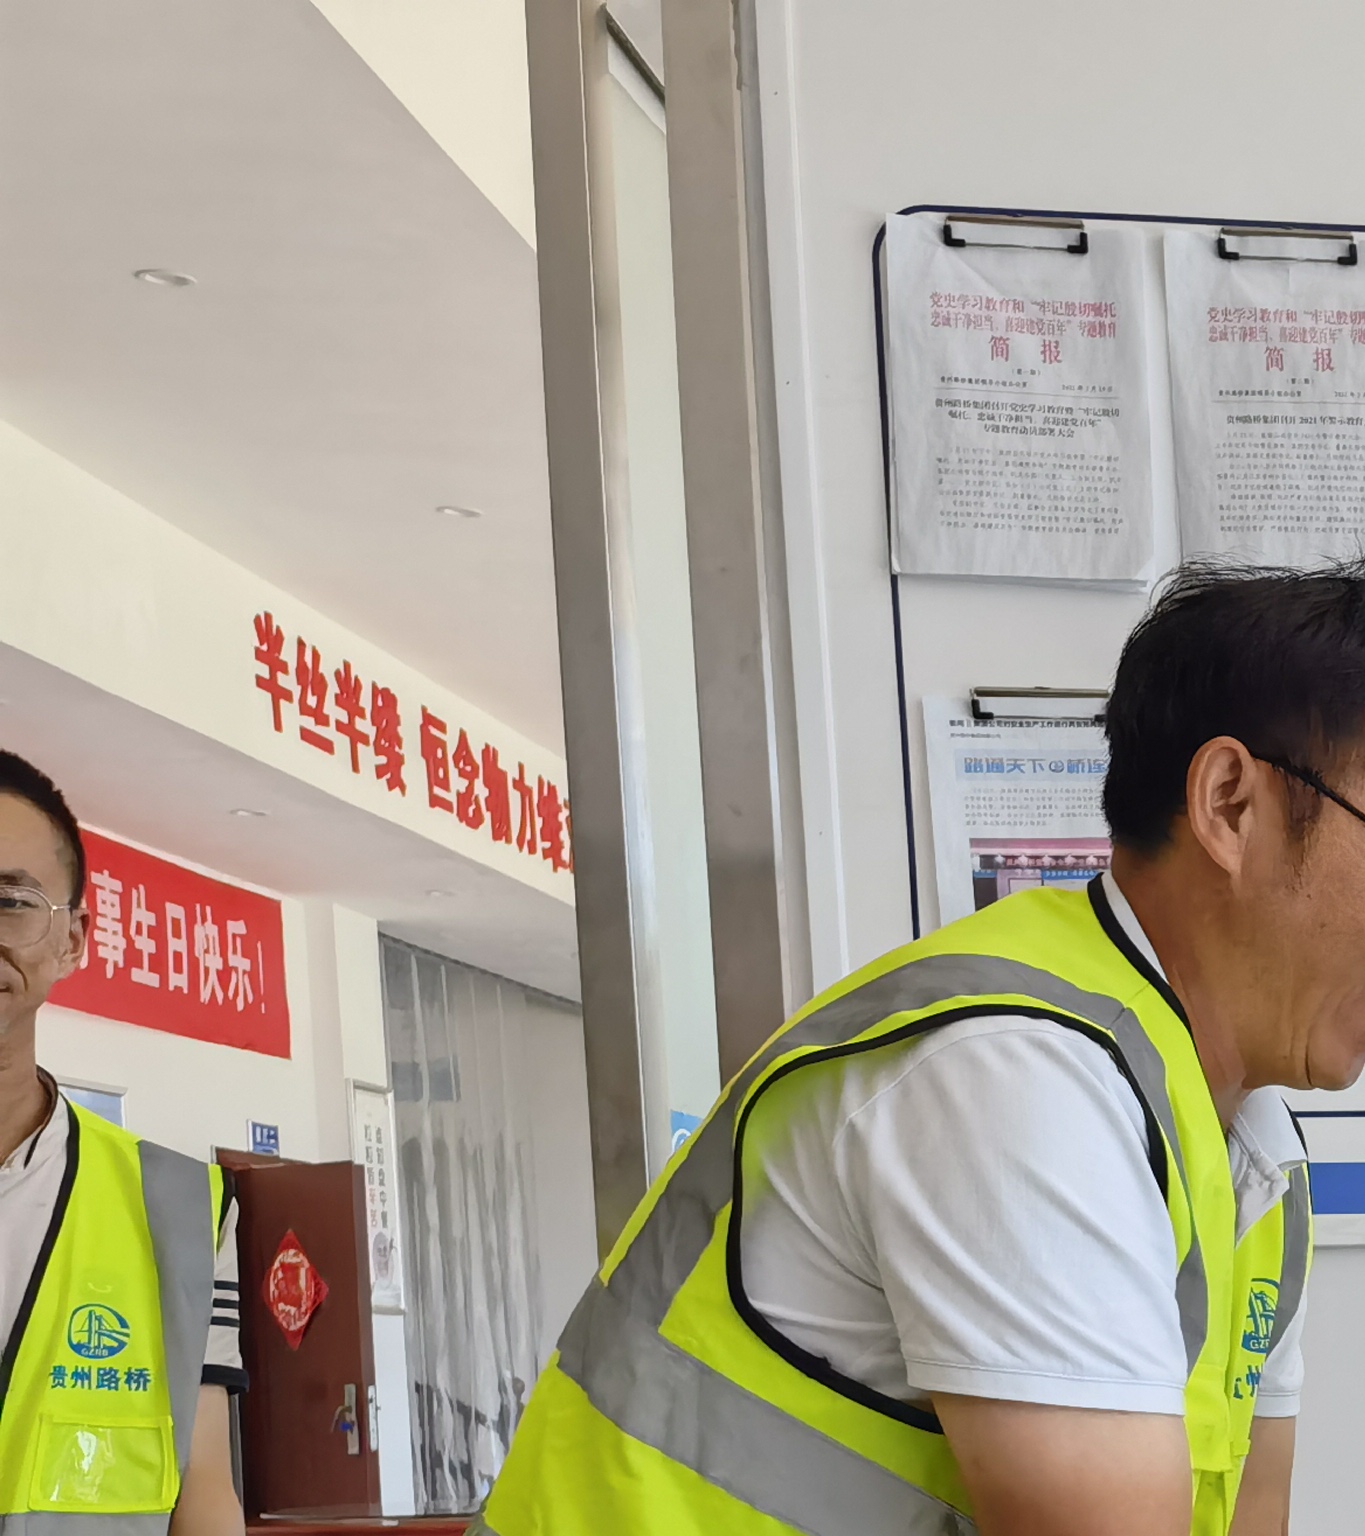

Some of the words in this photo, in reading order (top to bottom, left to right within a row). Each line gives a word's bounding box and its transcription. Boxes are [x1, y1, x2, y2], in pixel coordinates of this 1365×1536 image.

[988, 335, 1063, 365] 简报
[1264, 346, 1335, 372] 简报
[253, 610, 407, 797] 半丝半缕
[420, 704, 575, 873] 恒念物力维
[80, 869, 267, 1014] 事生日快乐！
[49, 1365, 152, 1392] 贵州路桥
